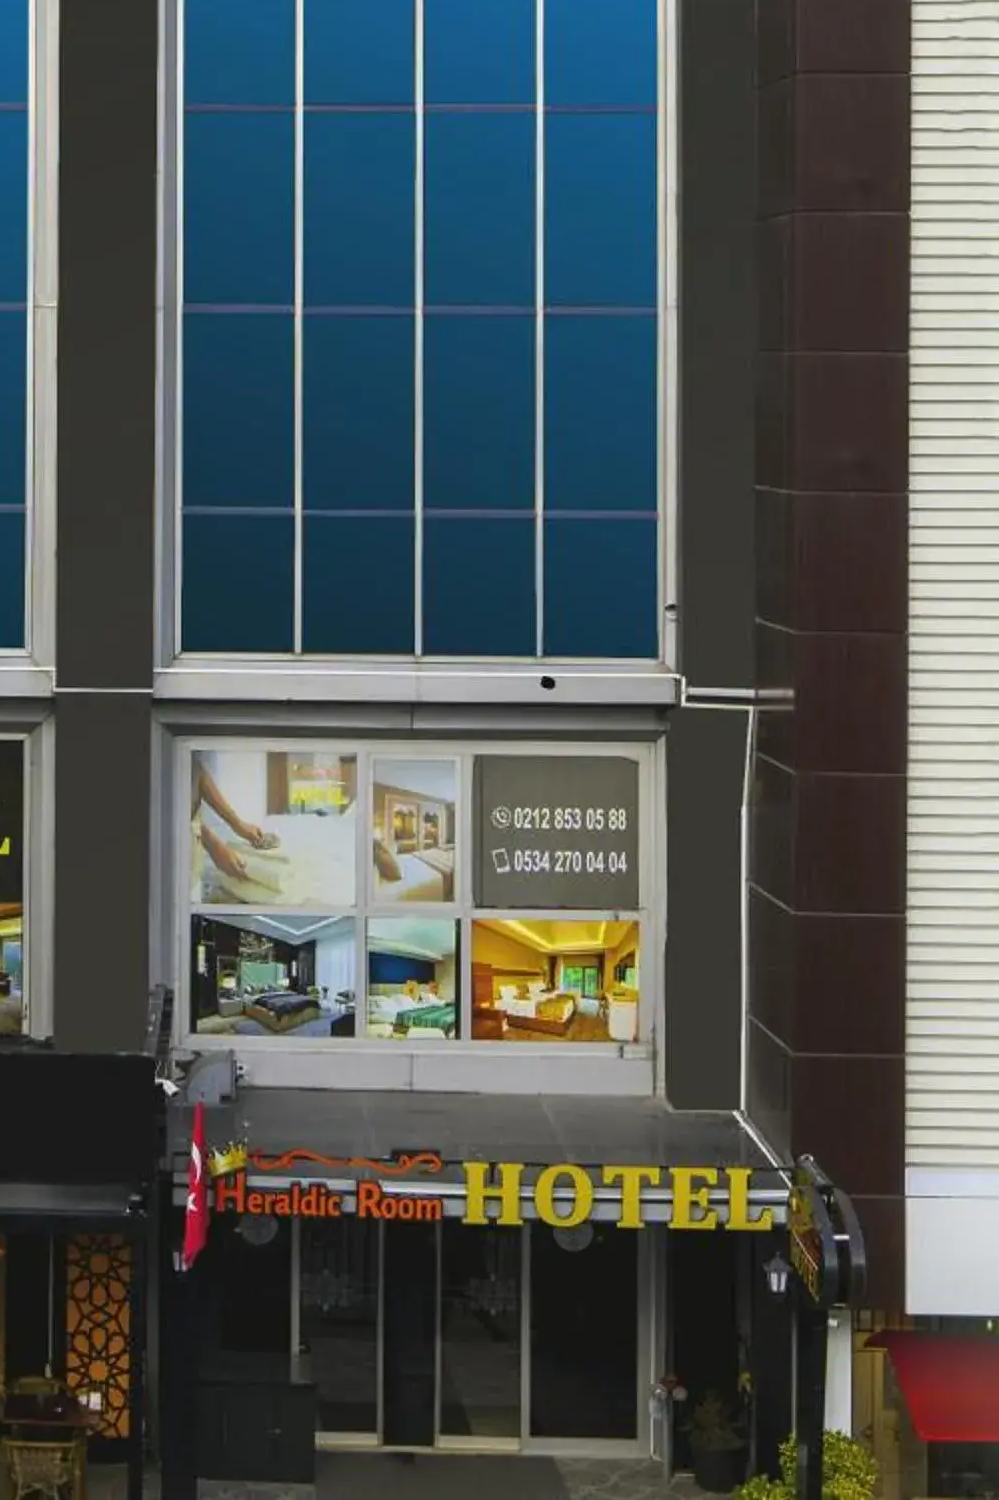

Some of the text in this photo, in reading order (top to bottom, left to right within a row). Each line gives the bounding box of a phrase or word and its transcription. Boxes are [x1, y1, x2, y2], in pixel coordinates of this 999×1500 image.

[514, 806, 628, 831] 0212 853 05 88
[514, 849, 628, 874] 0534 270 04 04
[215, 1161, 773, 1231] Heraldic Room HOTEL
